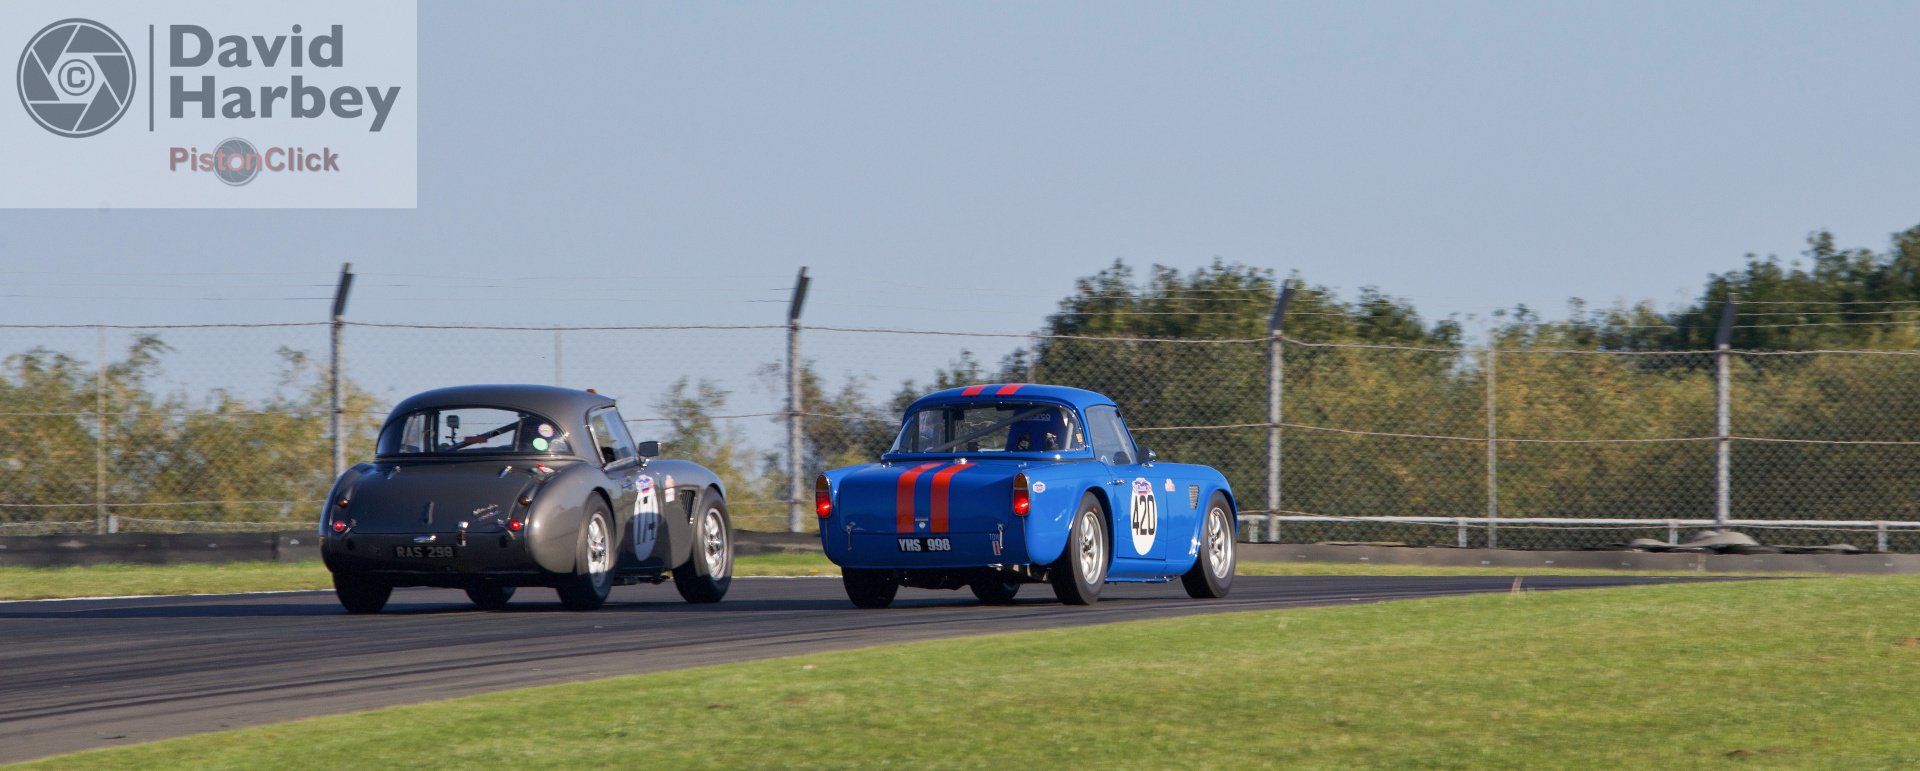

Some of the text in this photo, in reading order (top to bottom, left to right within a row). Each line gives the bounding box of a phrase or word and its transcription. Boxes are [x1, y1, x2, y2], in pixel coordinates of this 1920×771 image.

[1132, 494, 1156, 536] 420
[396, 546, 423, 558] RAS
[898, 538, 951, 552] YHS 998
